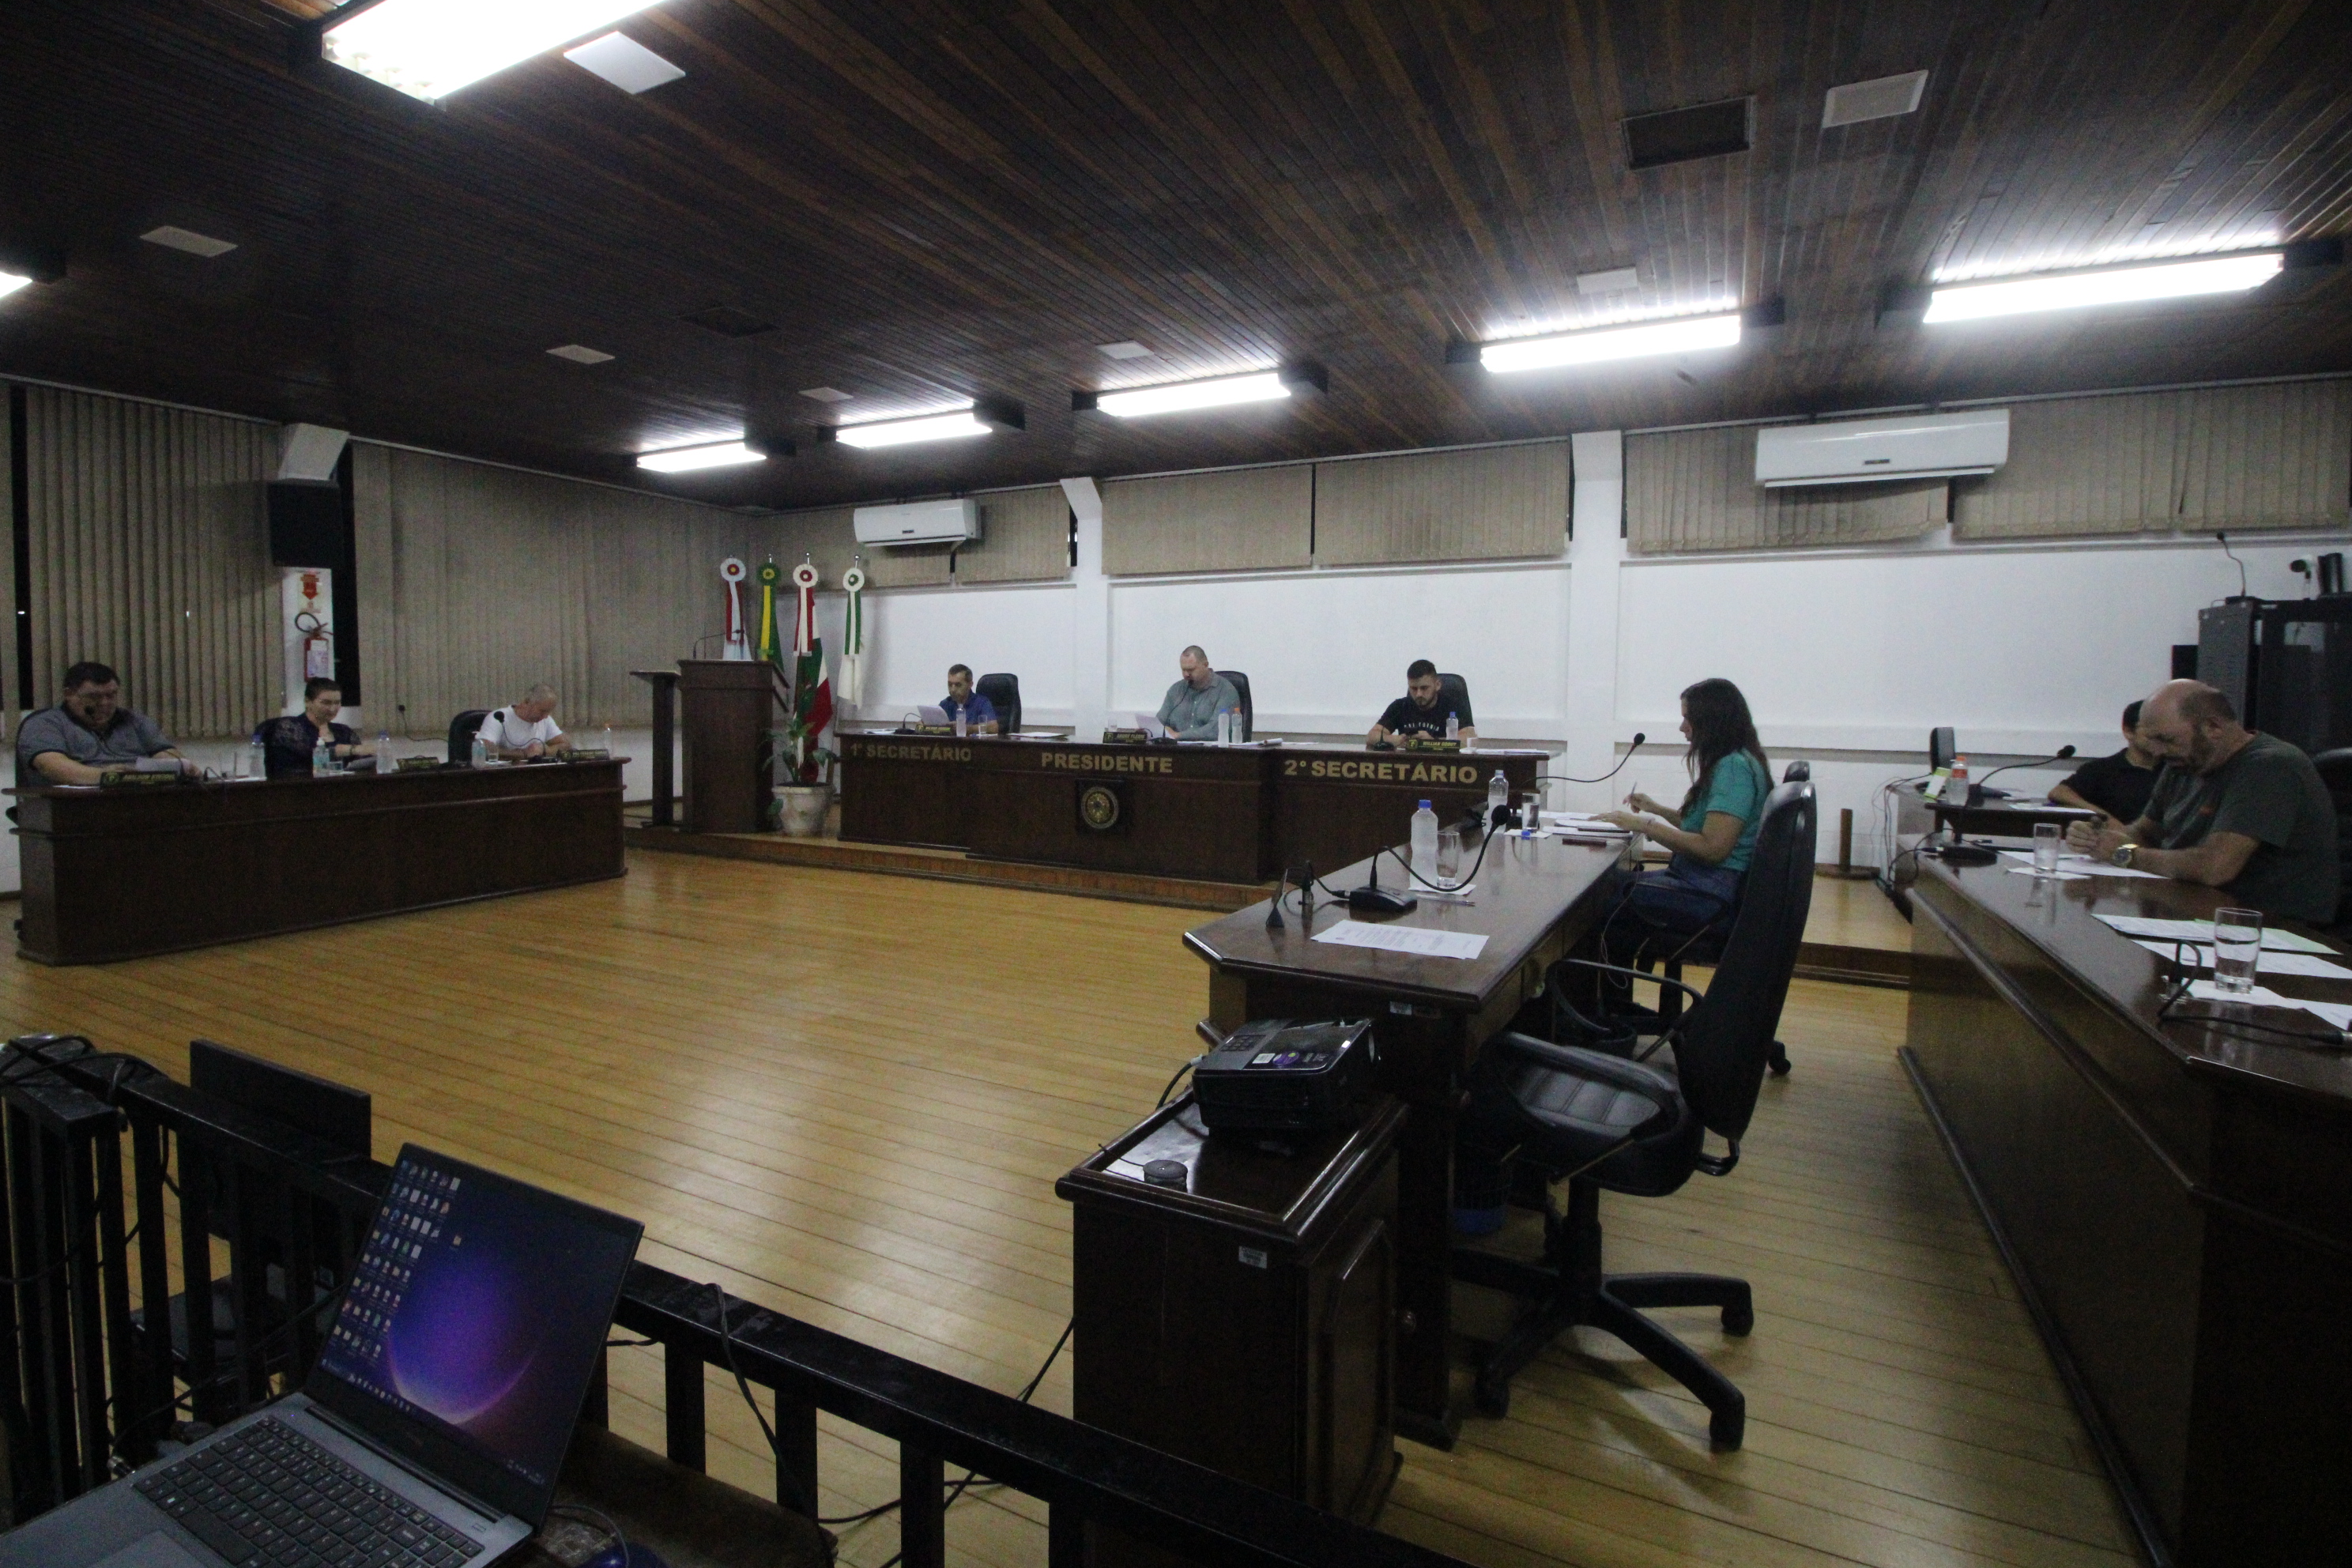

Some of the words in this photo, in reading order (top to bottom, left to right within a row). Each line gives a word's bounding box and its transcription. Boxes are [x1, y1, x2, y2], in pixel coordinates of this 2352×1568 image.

[866, 742, 972, 762] SECRETÁRIO
[1041, 752, 1173, 773] PRESIDENTE
[1310, 760, 1479, 784] SECRETÁRIO
